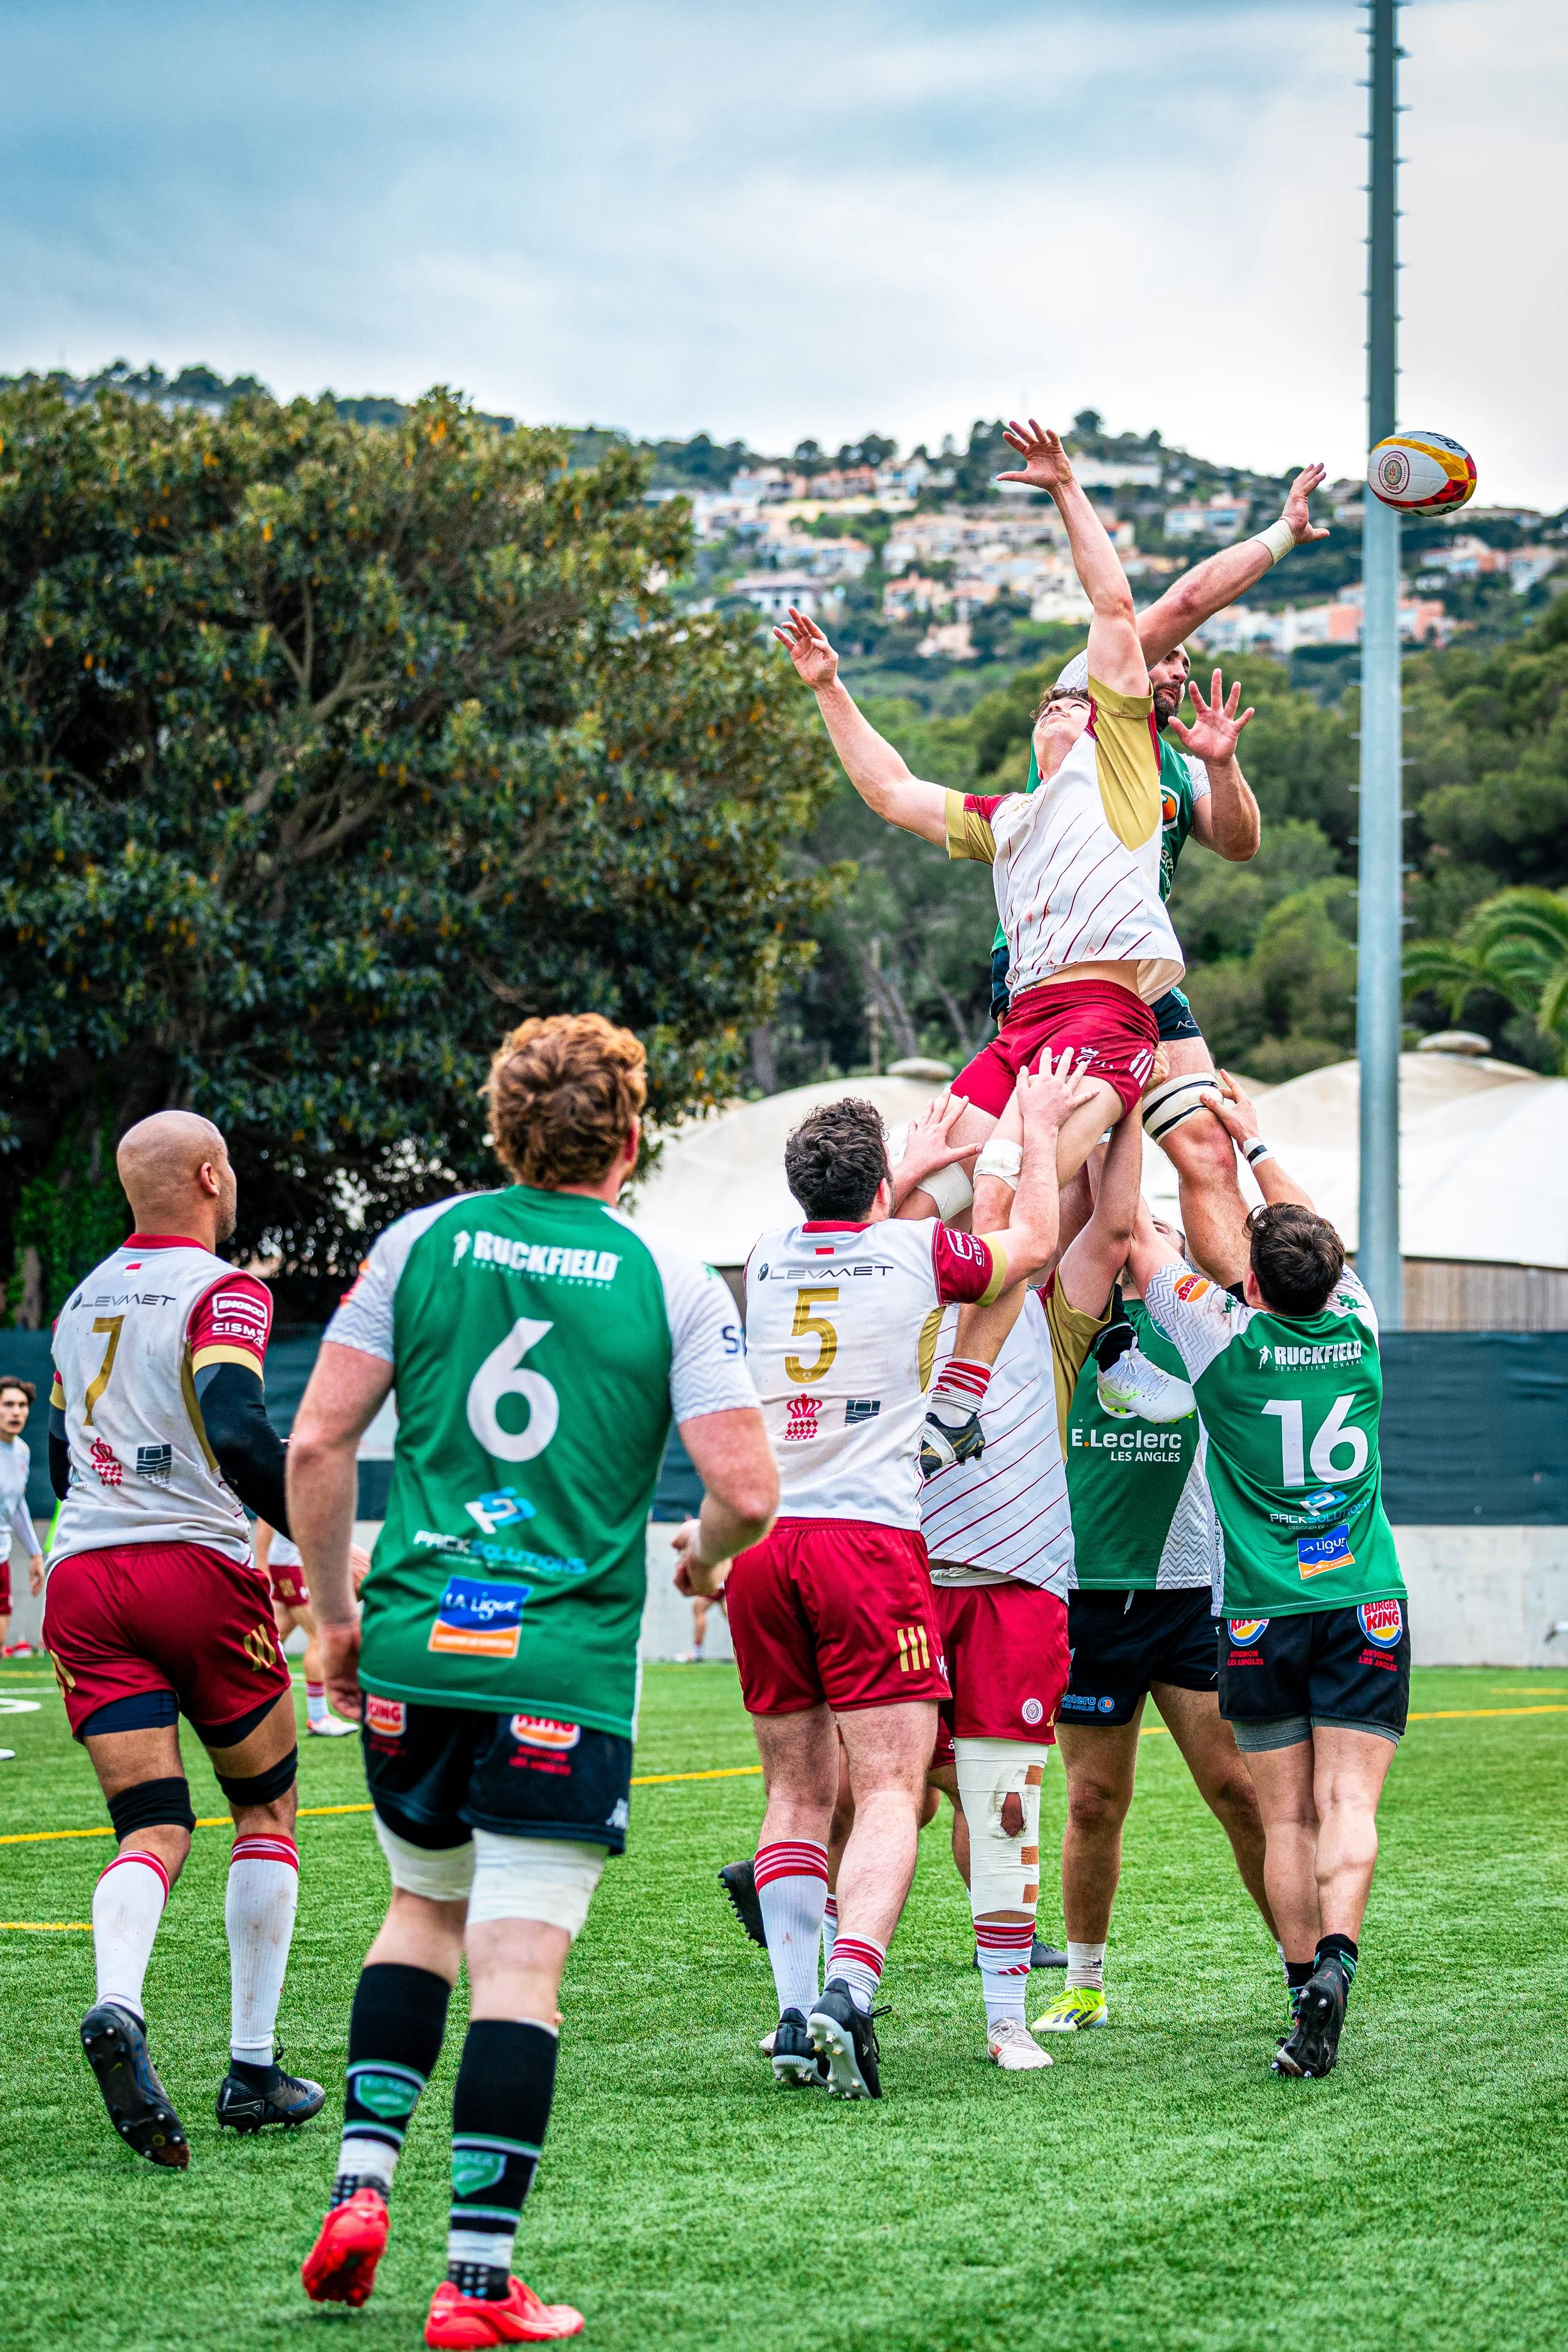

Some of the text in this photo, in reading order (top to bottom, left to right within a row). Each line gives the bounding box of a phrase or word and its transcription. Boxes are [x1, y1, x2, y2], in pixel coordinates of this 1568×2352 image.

[473, 1230, 619, 1281] RUCKFIELD
[770, 1265, 894, 1280] LEVMET
[82, 1293, 176, 1307] LEVMET
[785, 1287, 839, 1384] 5
[1274, 1340, 1362, 1365] RUCKFIELD
[83, 1314, 127, 1426] 7
[1333, 1358, 1364, 1368] CHABAL
[466, 1316, 560, 1463] 6
[1072, 1429, 1182, 1449] E.Leclerc
[1260, 1393, 1369, 1487] 16
[1111, 1451, 1180, 1462] LES ANGLES
[1364, 1599, 1397, 1616] BURGER
[1367, 1610, 1399, 1632] KING
[1358, 1656, 1398, 1672] LES ANGLES
[1362, 1648, 1394, 1662] AVIGNON
